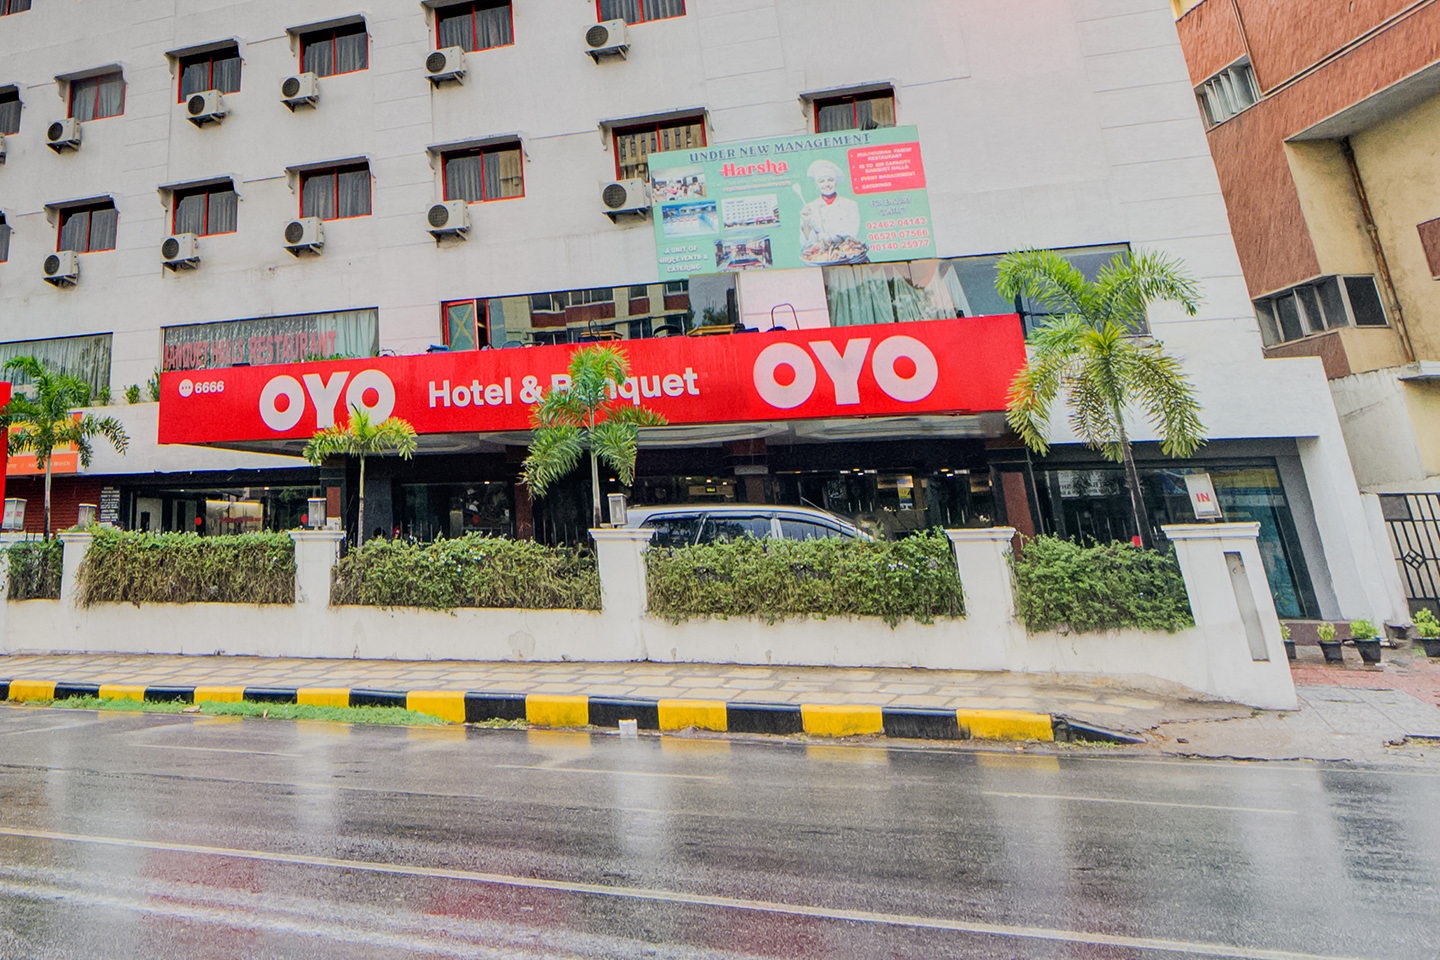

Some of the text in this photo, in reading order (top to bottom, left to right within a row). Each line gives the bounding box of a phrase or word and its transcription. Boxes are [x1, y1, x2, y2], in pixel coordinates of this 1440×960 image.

[689, 133, 870, 163] UNDER NEW MANAGEMENT
[719, 158, 788, 177] Harsha
[866, 216, 927, 229] 92462 04143
[870, 242, 898, 252] 90140
[250, 331, 337, 363] RESTAURANT
[753, 335, 938, 409] OYO
[195, 380, 224, 394] 6666
[428, 367, 700, 408] Hotel & Bnquet
[259, 369, 396, 431] OYO
[1196, 493, 1210, 502] IN
